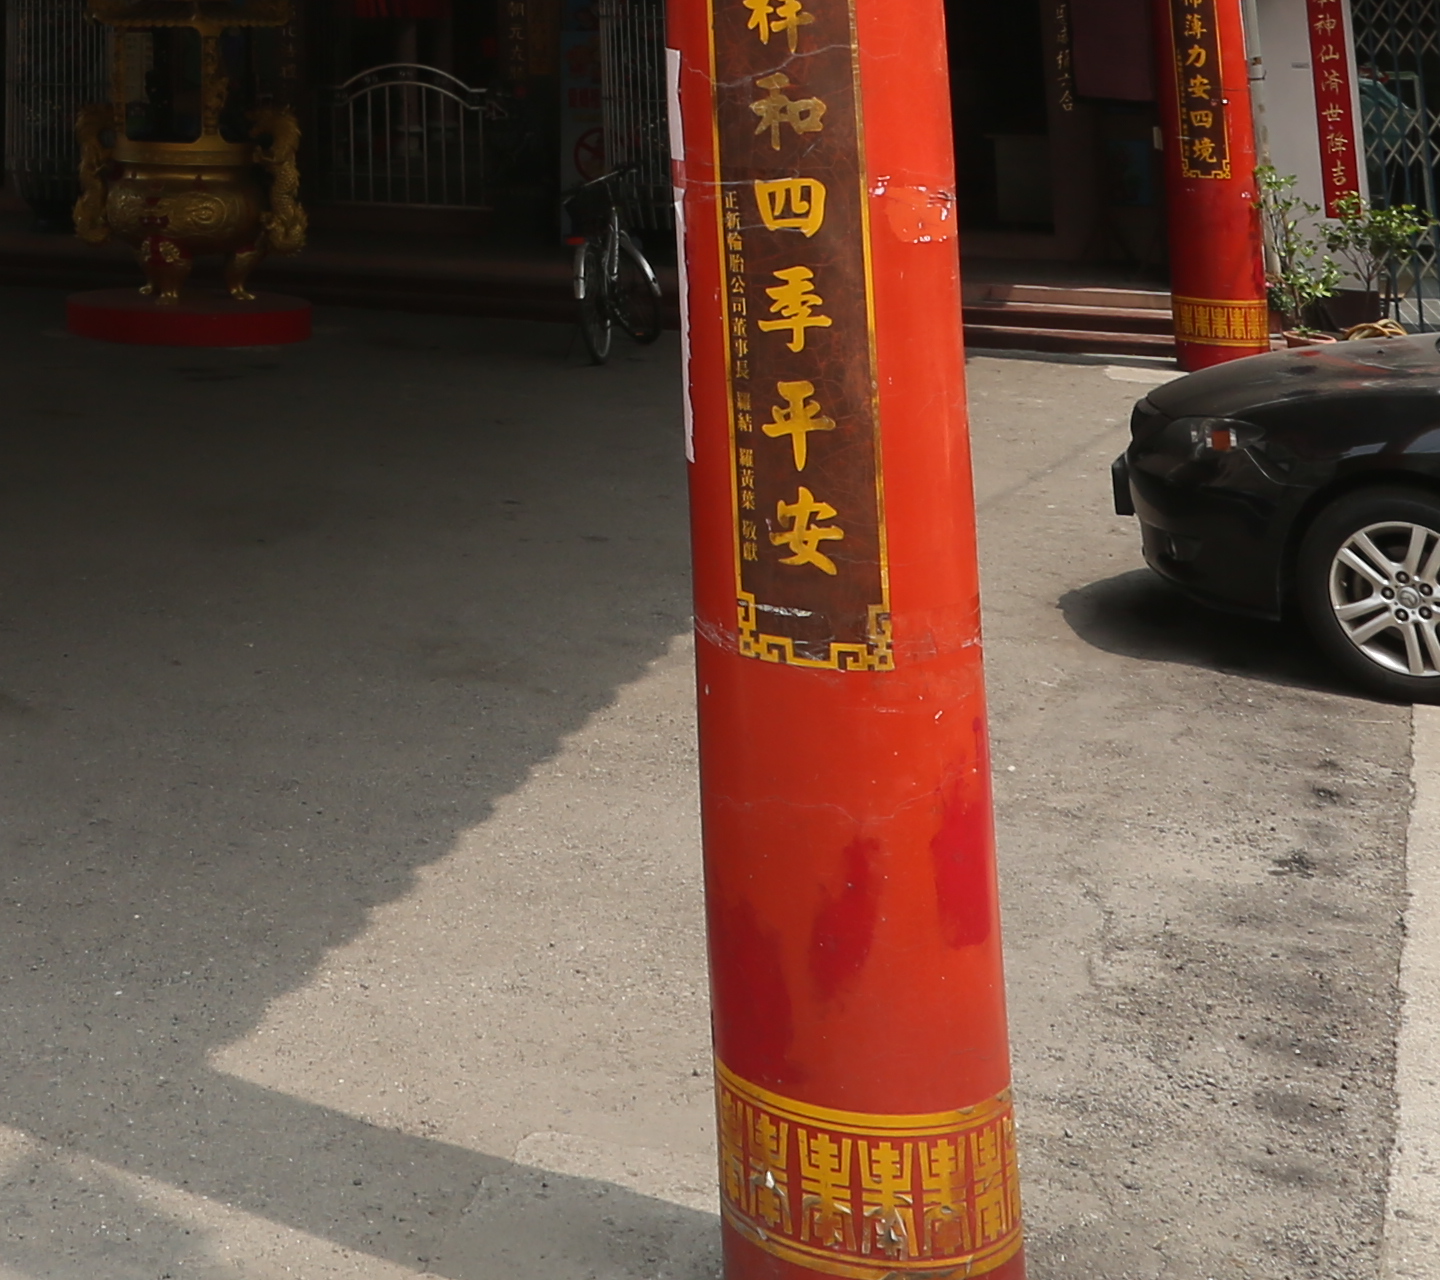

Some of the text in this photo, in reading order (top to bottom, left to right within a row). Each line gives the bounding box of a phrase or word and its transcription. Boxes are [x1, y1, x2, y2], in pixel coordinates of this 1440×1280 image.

[724, 189, 750, 381] 正新輪胎公司董事長
